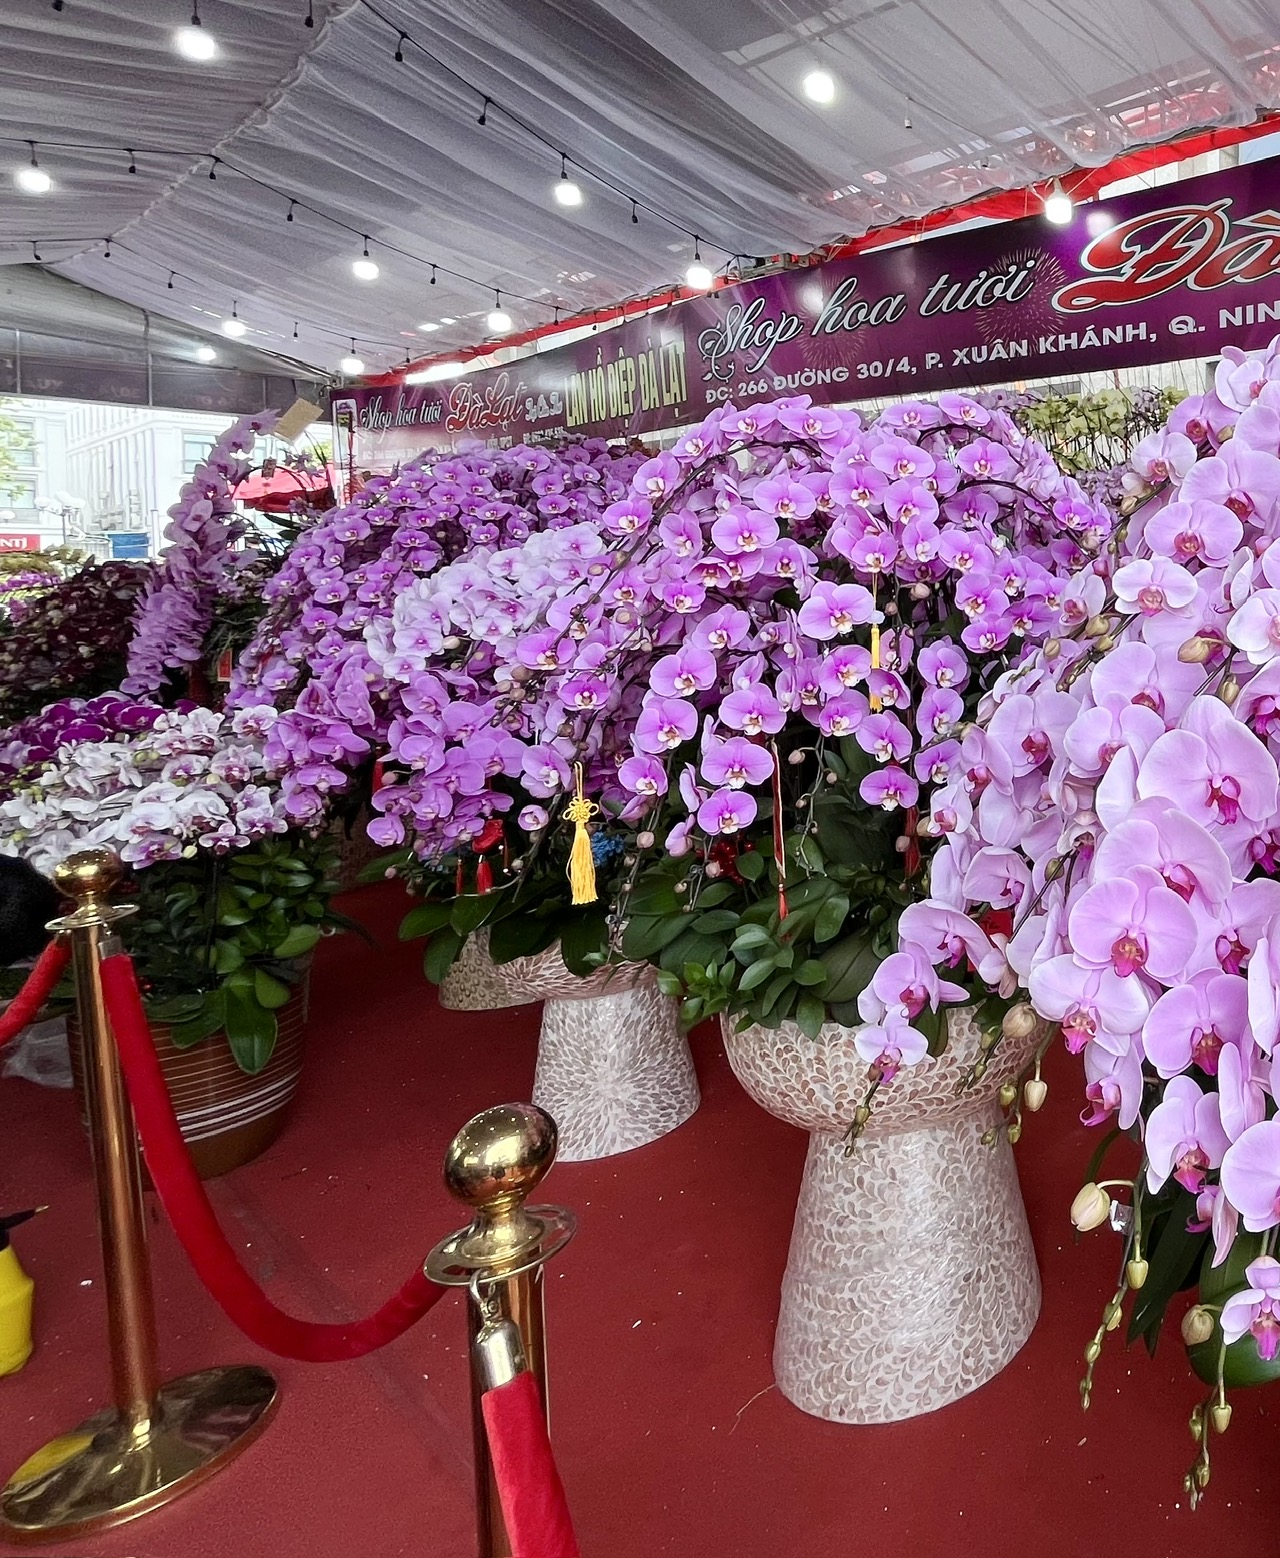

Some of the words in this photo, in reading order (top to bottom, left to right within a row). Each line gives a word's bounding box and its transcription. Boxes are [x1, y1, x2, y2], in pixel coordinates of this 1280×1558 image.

[699, 296, 804, 380] Shop
[811, 276, 906, 338] hoa
[918, 256, 1037, 316] tươi
[705, 387, 734, 403] ĐC:
[738, 379, 768, 397] 266
[773, 366, 849, 390] ĐƯỜNG
[856, 356, 917, 379] 30/4,
[925, 353, 943, 370] P.
[951, 339, 1028, 367] XUÂN
[1038, 321, 1157, 354] KHÁNH,
[1168, 315, 1206, 335] Q.
[360, 396, 391, 444] Shop
[394, 396, 416, 427] hoa
[564, 370, 588, 427] LAN
[659, 341, 688, 418] LẠT
